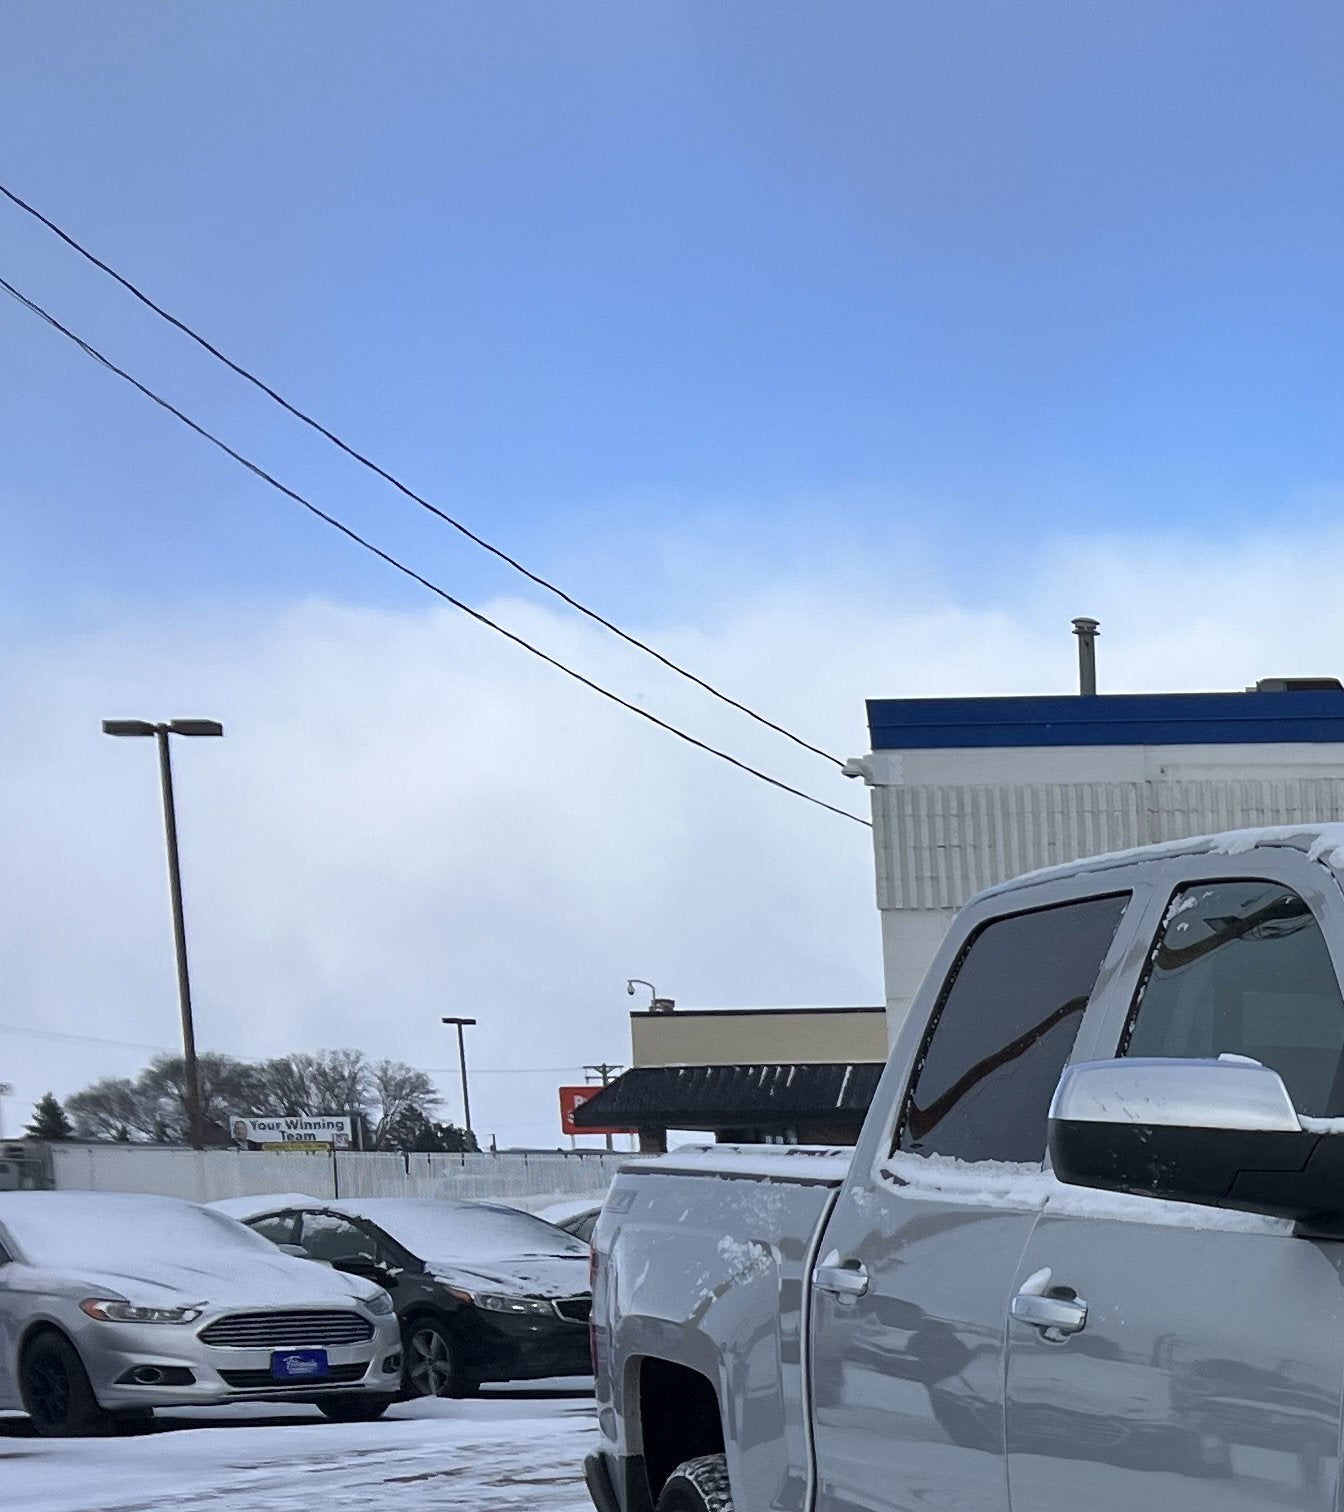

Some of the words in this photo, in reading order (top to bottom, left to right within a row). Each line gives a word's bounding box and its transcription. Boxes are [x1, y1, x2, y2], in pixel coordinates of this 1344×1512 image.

[250, 1120, 281, 1131] Your
[284, 1119, 344, 1132] Winning
[280, 1131, 317, 1141] Team
